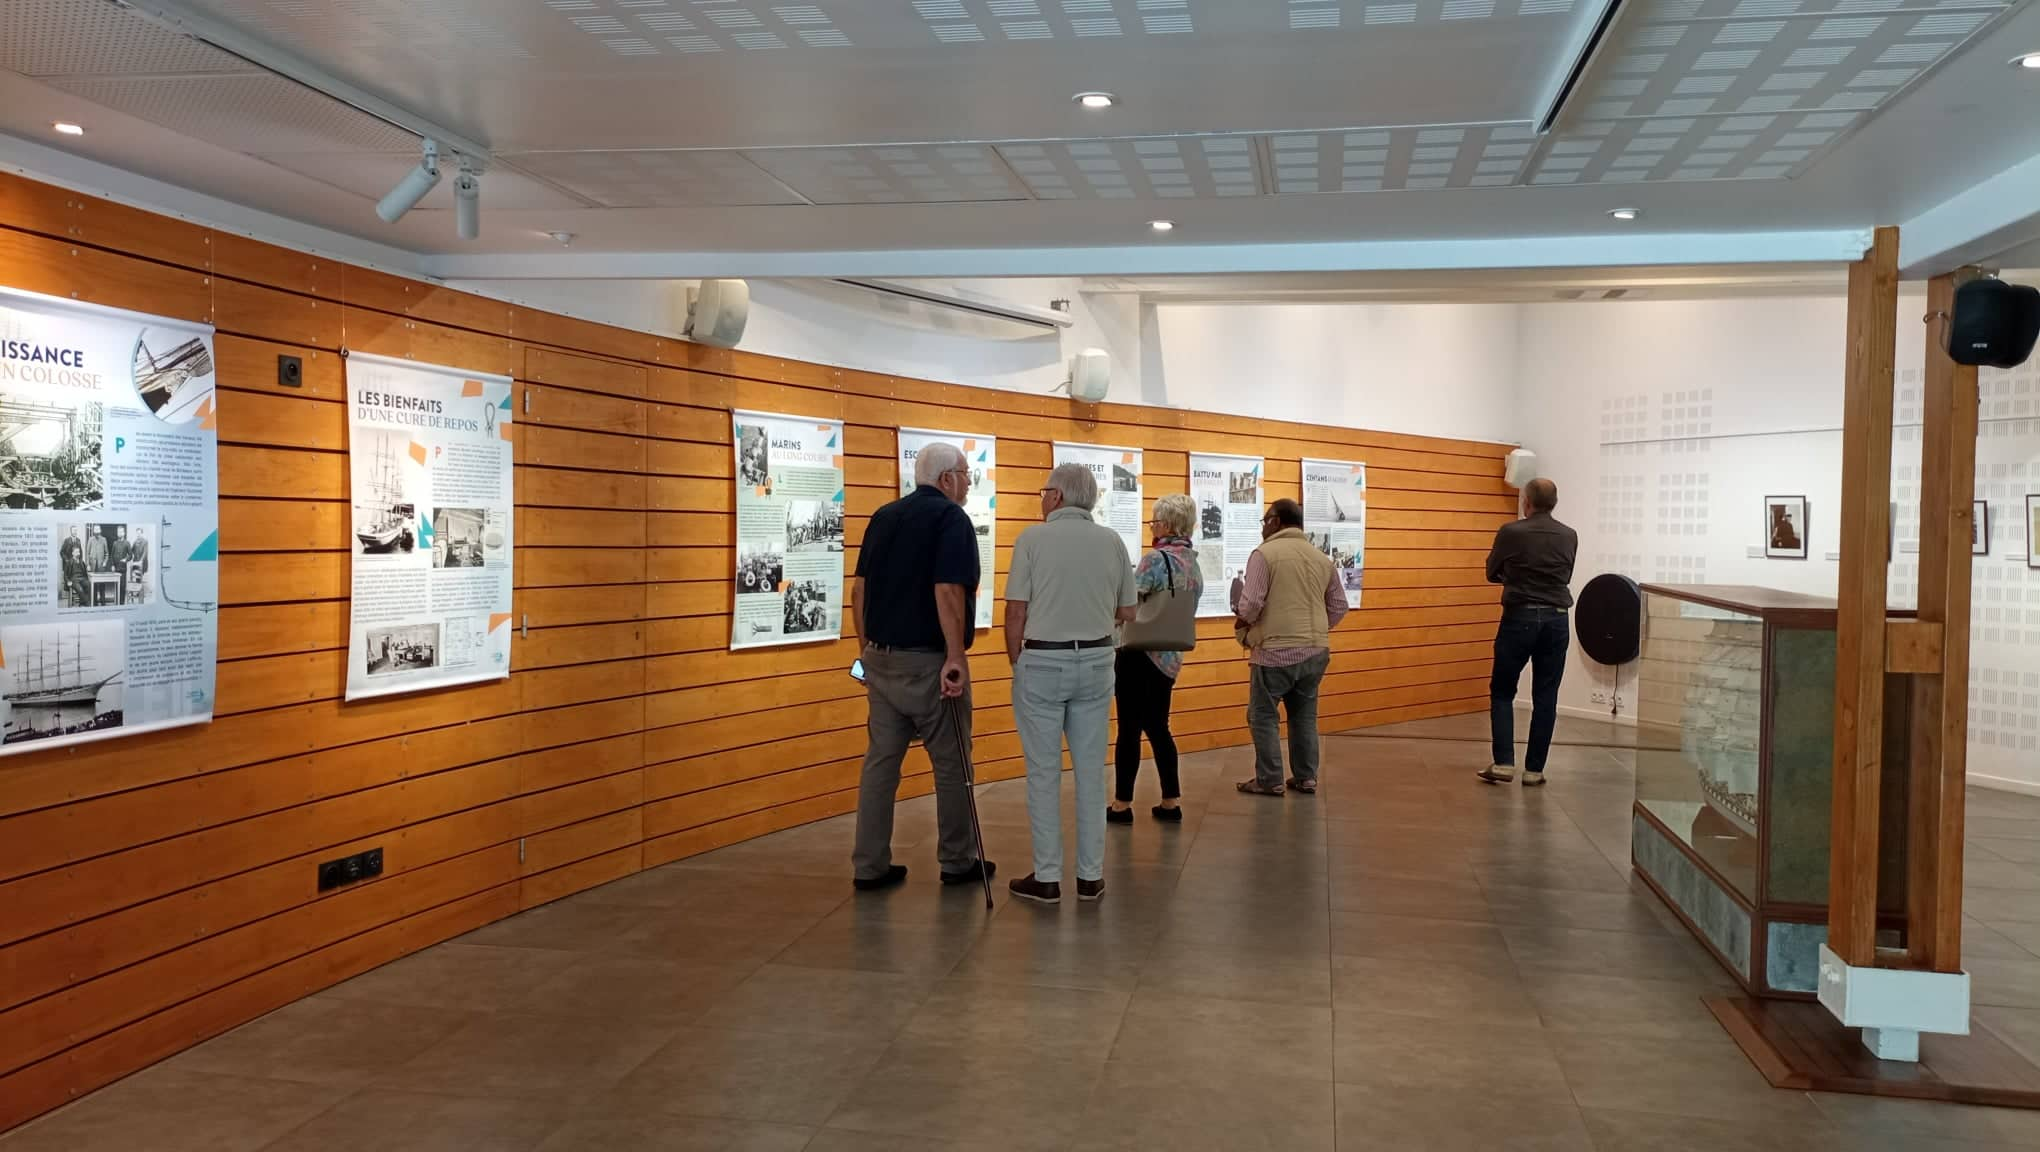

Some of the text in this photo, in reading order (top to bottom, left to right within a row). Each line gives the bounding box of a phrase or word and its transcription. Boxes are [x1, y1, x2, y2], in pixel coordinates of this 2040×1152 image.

[2, 339, 84, 368] ISSANCE
[0, 362, 104, 391] N COLOSSE
[358, 390, 443, 414] LES BIENFAITS
[358, 406, 479, 432] D'UNE CURE DE REPOS
[115, 437, 126, 454] P
[771, 440, 802, 450] MARINS
